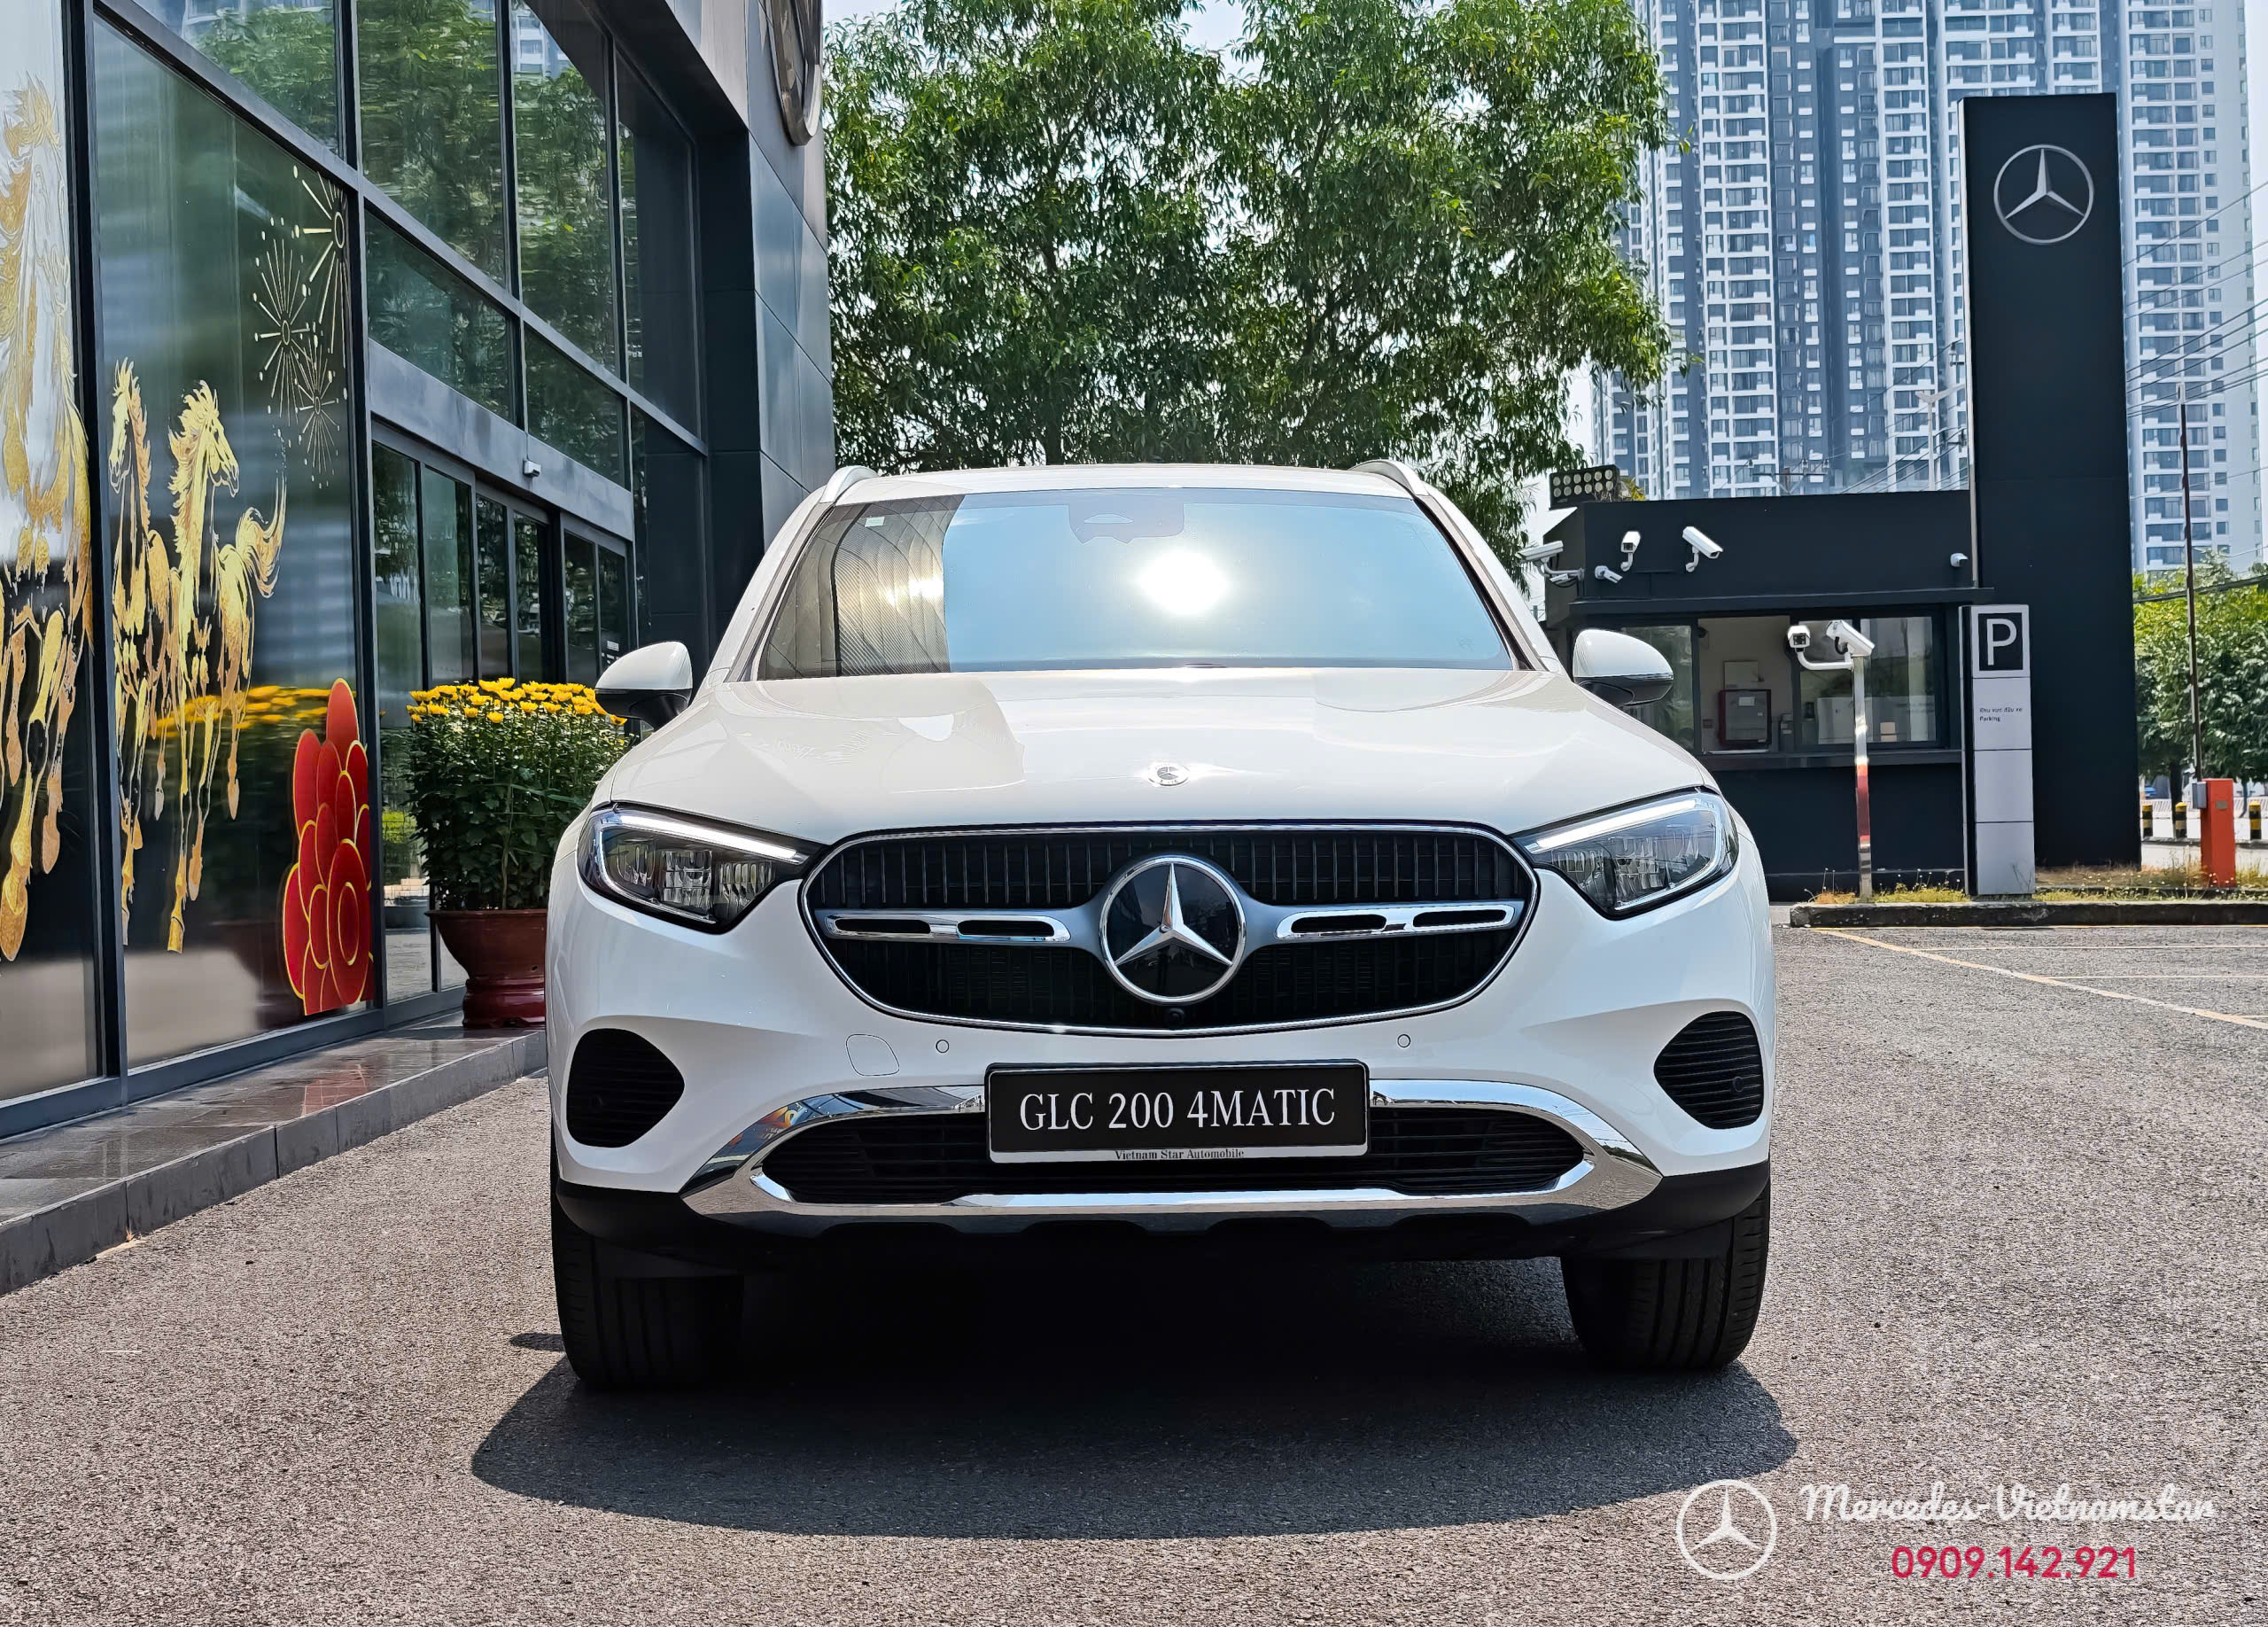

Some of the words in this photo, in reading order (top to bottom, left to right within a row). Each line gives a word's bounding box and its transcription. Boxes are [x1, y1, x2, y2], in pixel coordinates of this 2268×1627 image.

[1986, 618, 2017, 666] P
[1020, 1093, 1093, 1131] GLC
[1108, 1092, 1174, 1129] 200
[1187, 1088, 1335, 1128] 4MATIC
[1115, 1149, 1158, 1160] Vietnam
[1161, 1149, 1184, 1160] Star
[1186, 1148, 1245, 1159] Automobile
